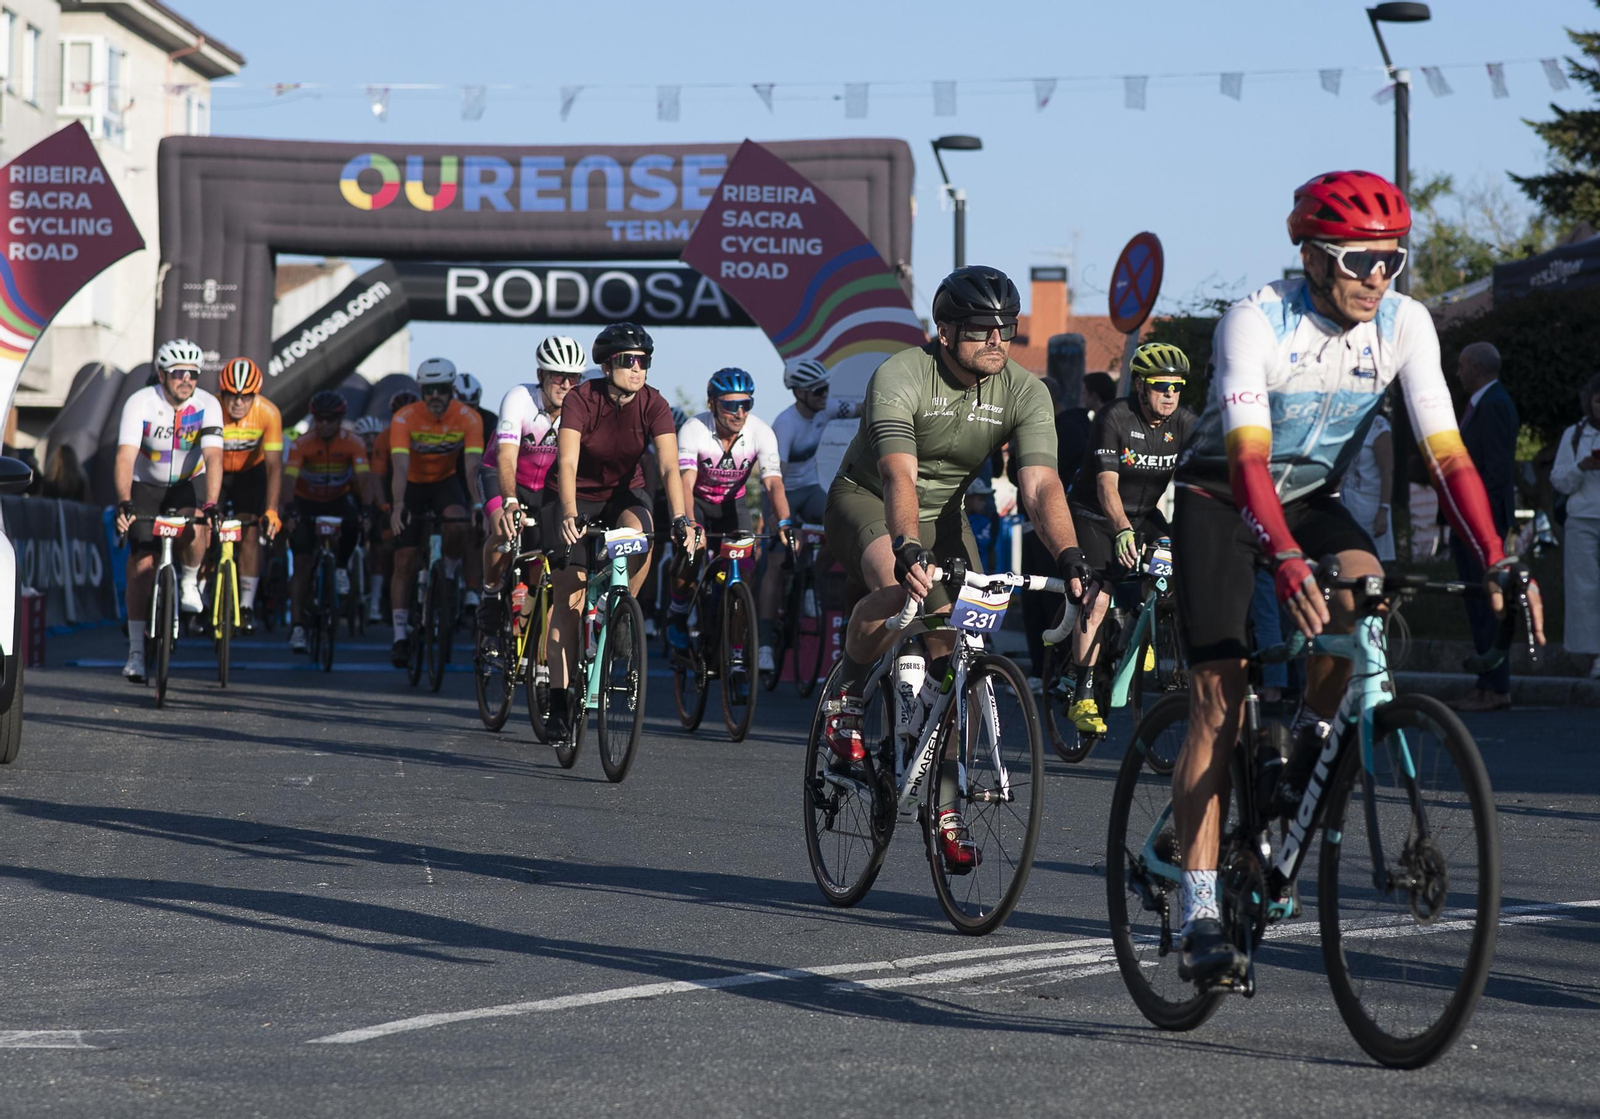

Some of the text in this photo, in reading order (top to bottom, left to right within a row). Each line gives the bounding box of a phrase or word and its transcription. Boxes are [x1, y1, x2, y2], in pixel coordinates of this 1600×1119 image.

[9, 165, 106, 185] RIBEIRA
[339, 152, 728, 212] OURENSE
[9, 190, 93, 210] SACRA
[722, 184, 817, 205] RIBEIRA
[8, 216, 114, 236] CYCLING
[721, 210, 804, 230] SACRA
[9, 242, 79, 261] ROAD
[720, 235, 824, 256] CYCLING
[720, 261, 789, 280] ROAD
[446, 267, 732, 320] RODOSA
[614, 540, 643, 556] 254
[728, 549, 745, 559] 64
[962, 610, 997, 629] 231
